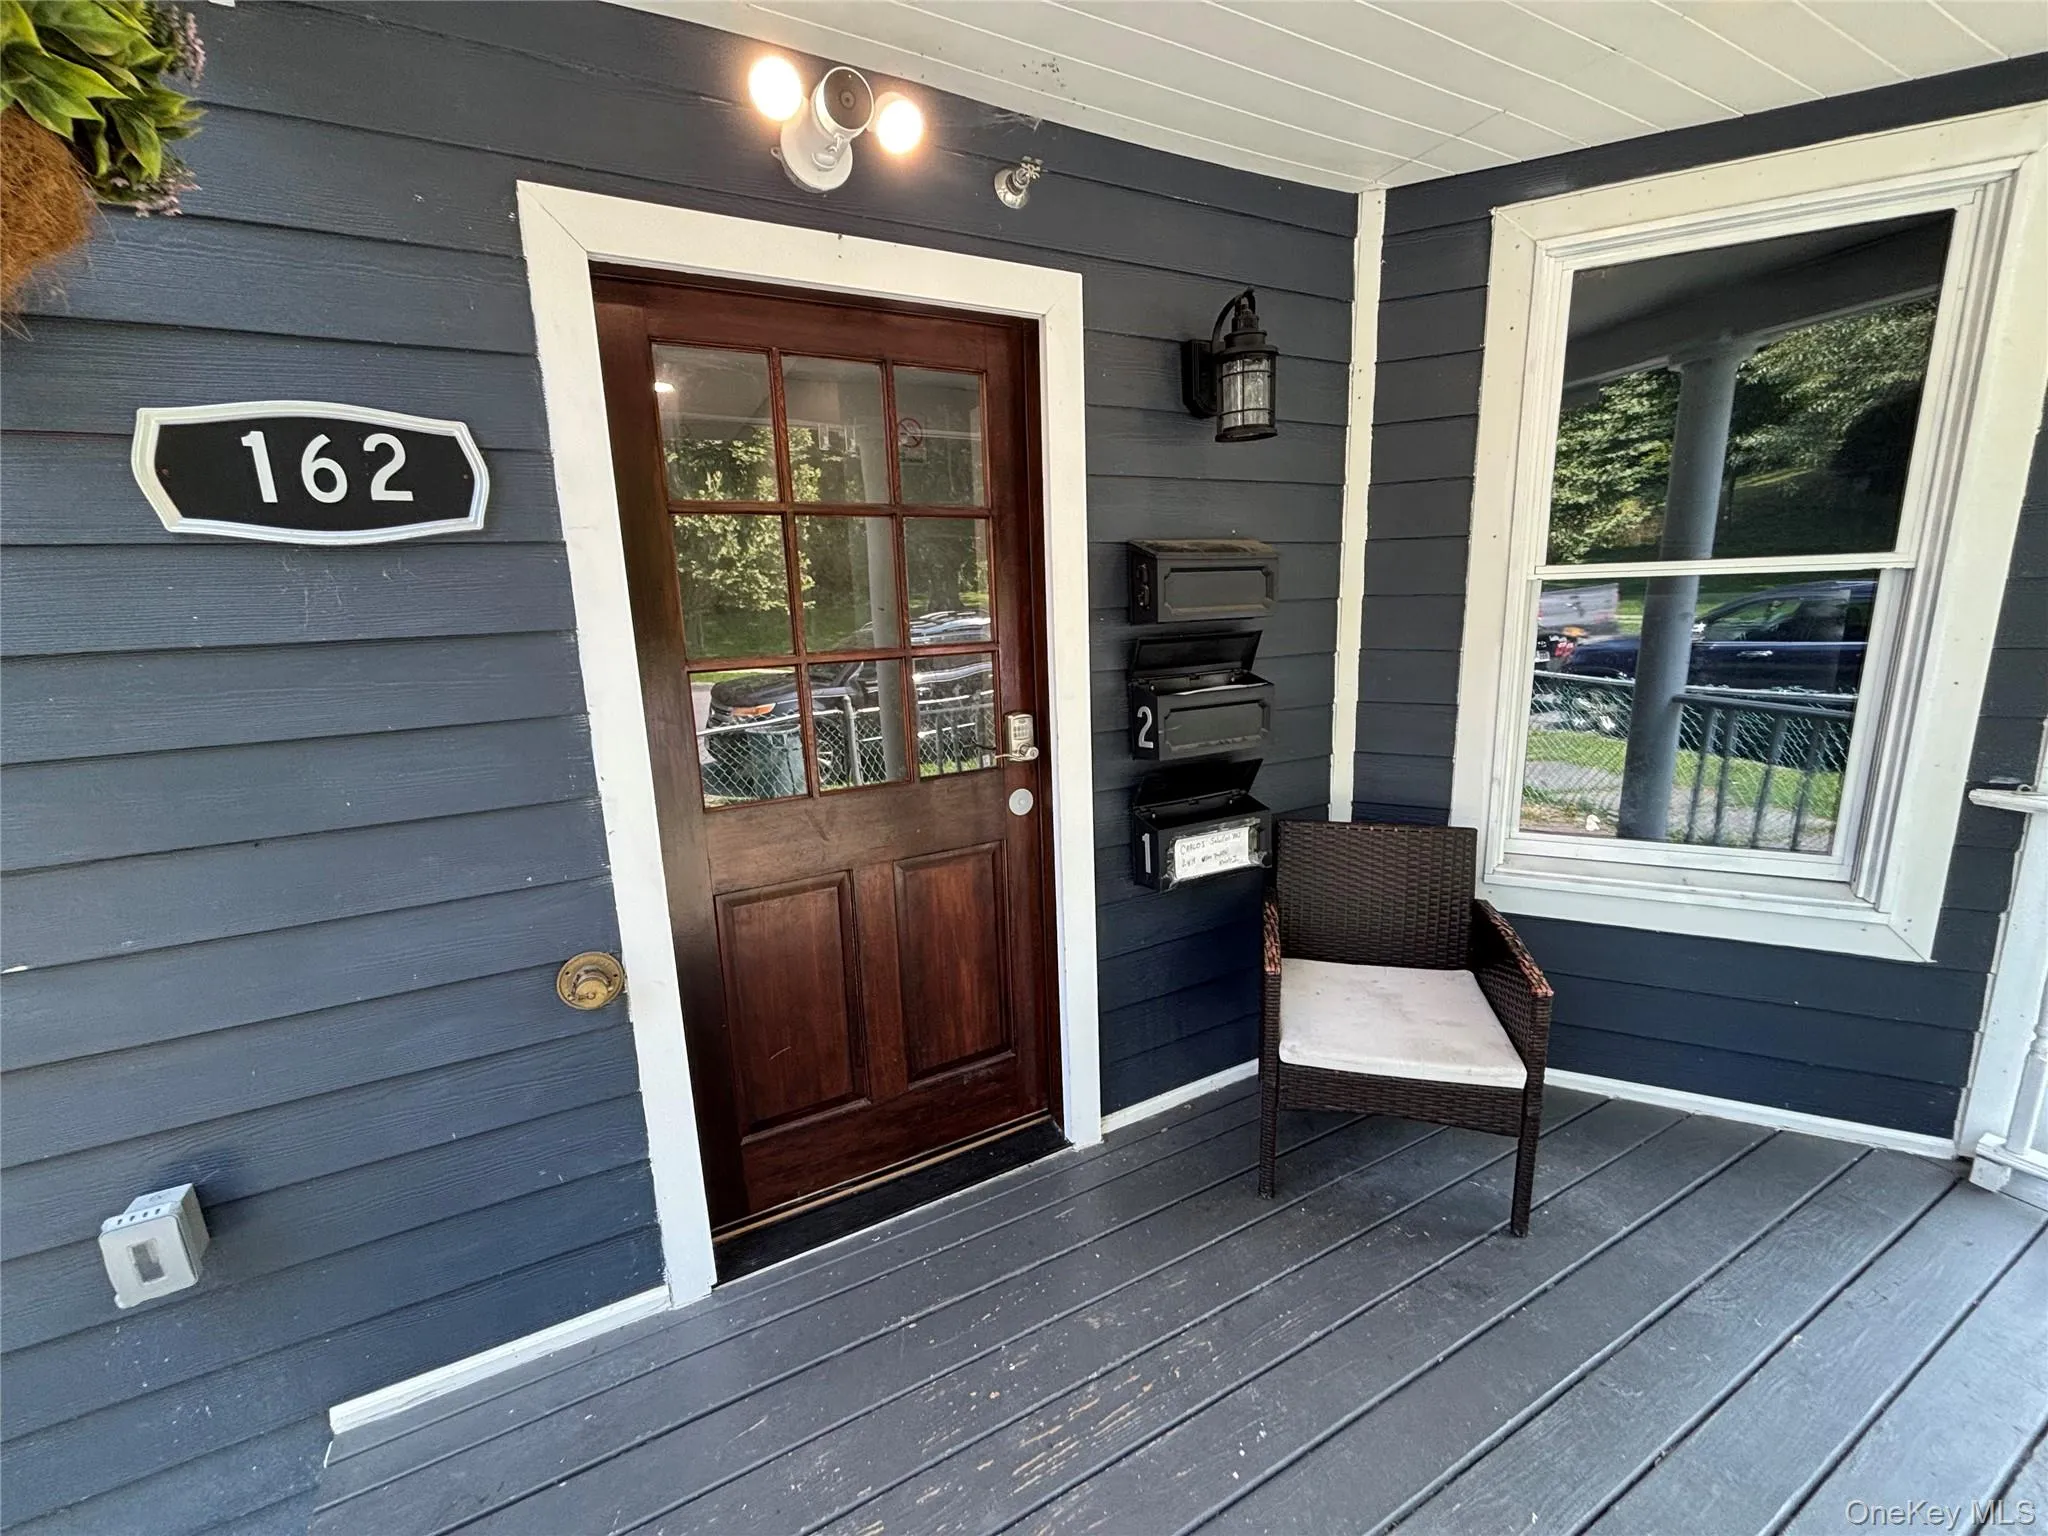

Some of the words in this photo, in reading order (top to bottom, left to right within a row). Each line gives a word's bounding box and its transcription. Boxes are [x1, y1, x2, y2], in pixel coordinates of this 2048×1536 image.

[240, 431, 414, 503] 162
[1137, 706, 1154, 749] 2
[1142, 833, 1152, 874] 1
